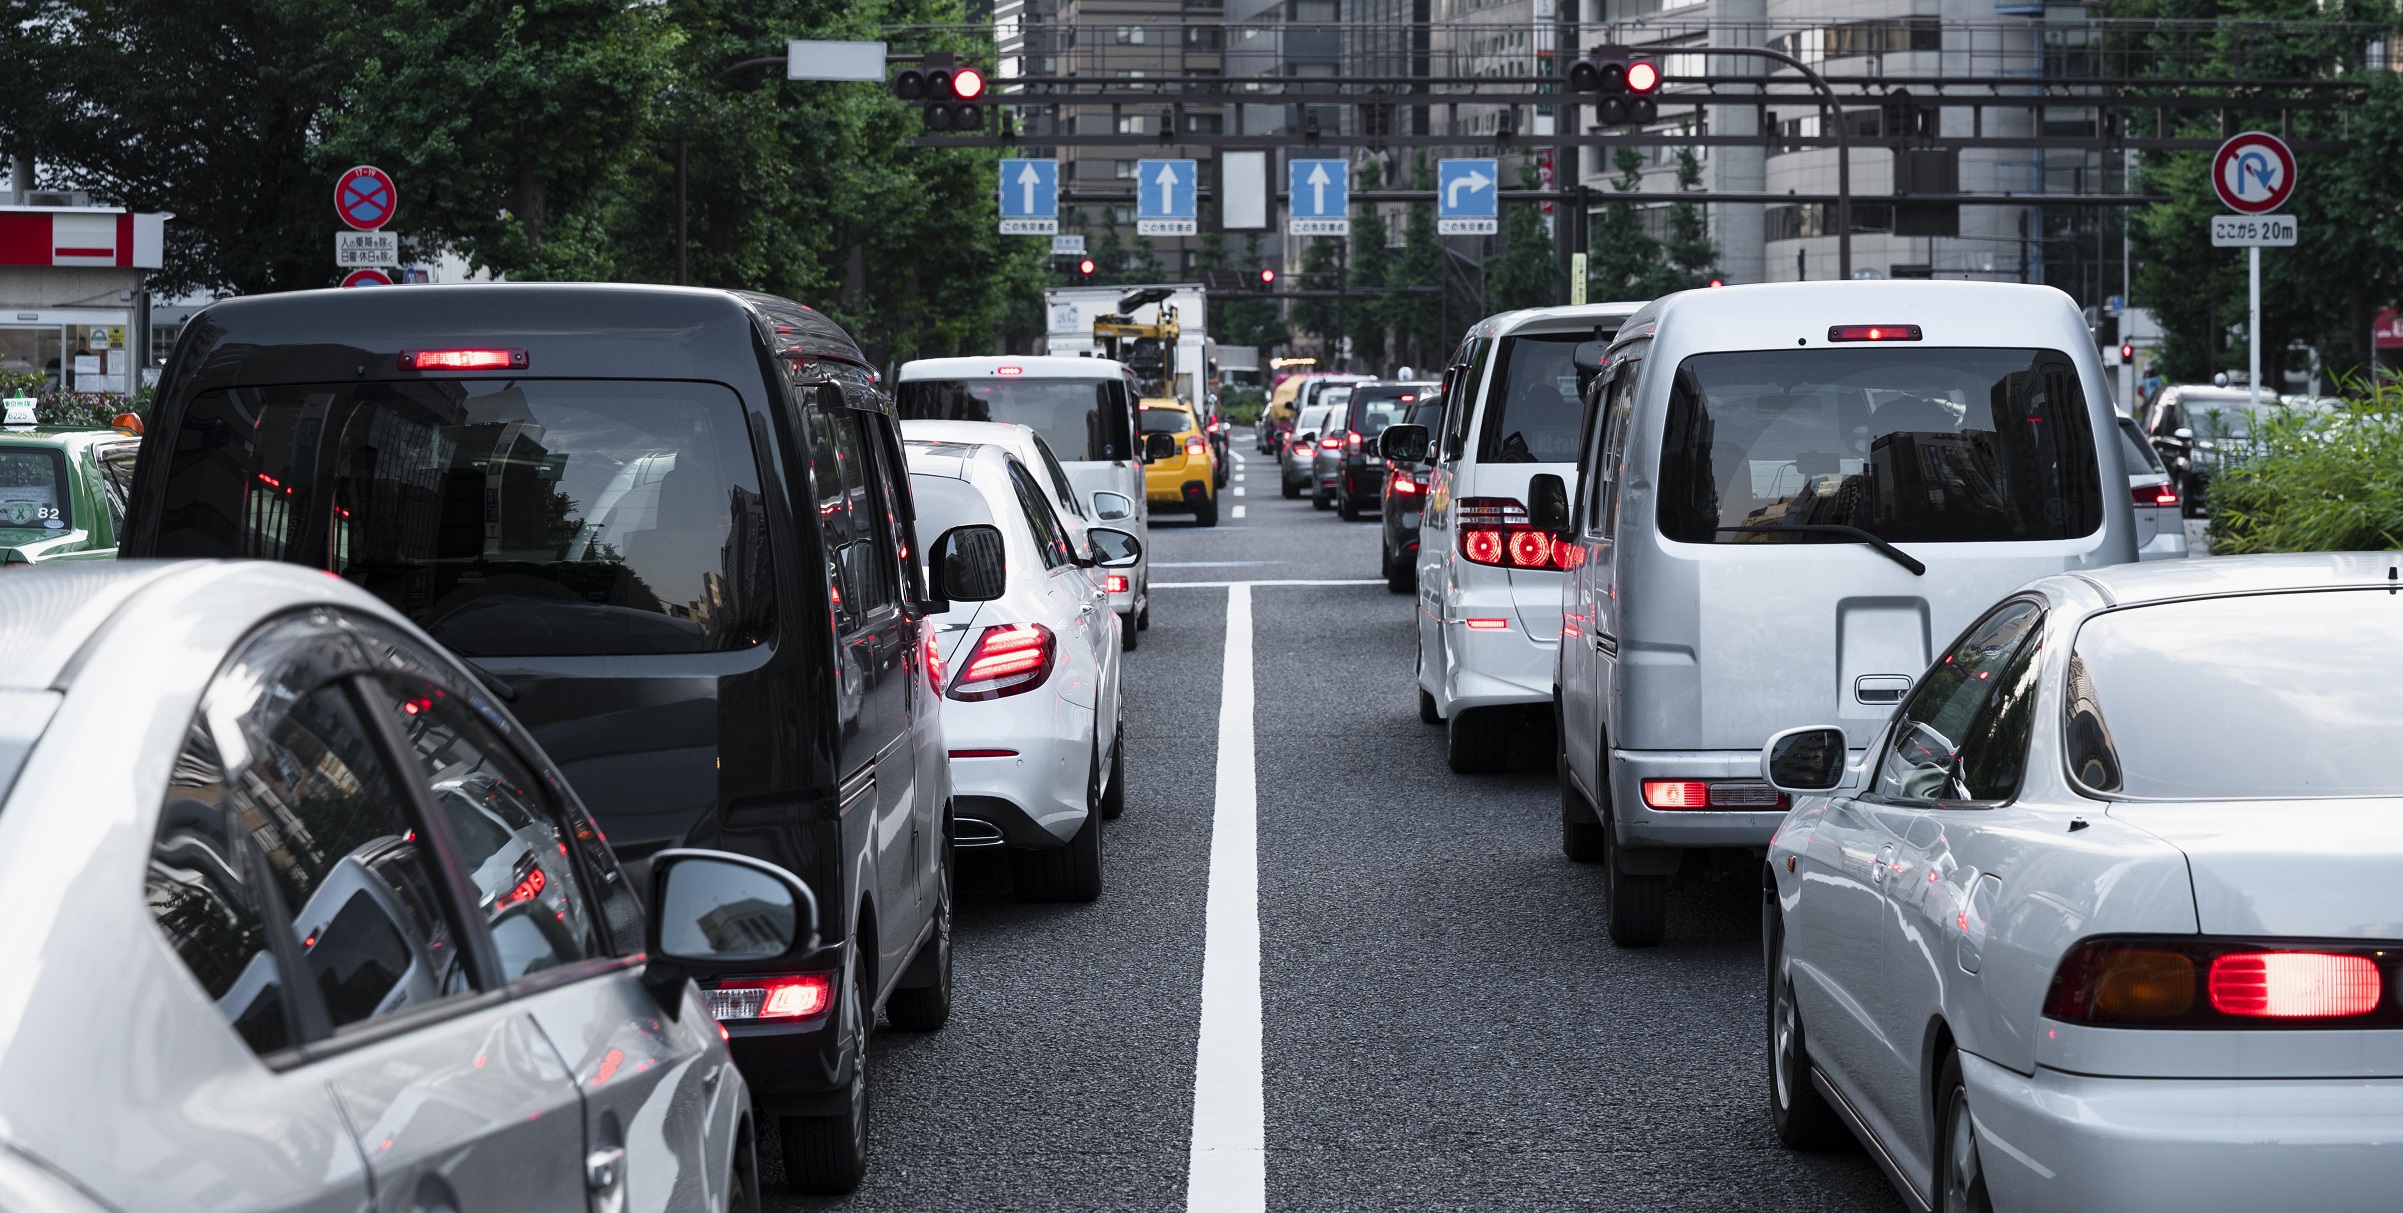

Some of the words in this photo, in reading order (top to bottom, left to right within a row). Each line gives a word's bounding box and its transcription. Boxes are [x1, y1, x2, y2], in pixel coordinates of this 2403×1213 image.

[2216, 223, 2258, 239] ここから
[2262, 221, 2293, 240] 20m
[341, 236, 393, 250] 人の乗降を除く
[8, 412, 28, 420] 6225
[37, 507, 60, 520] 82
